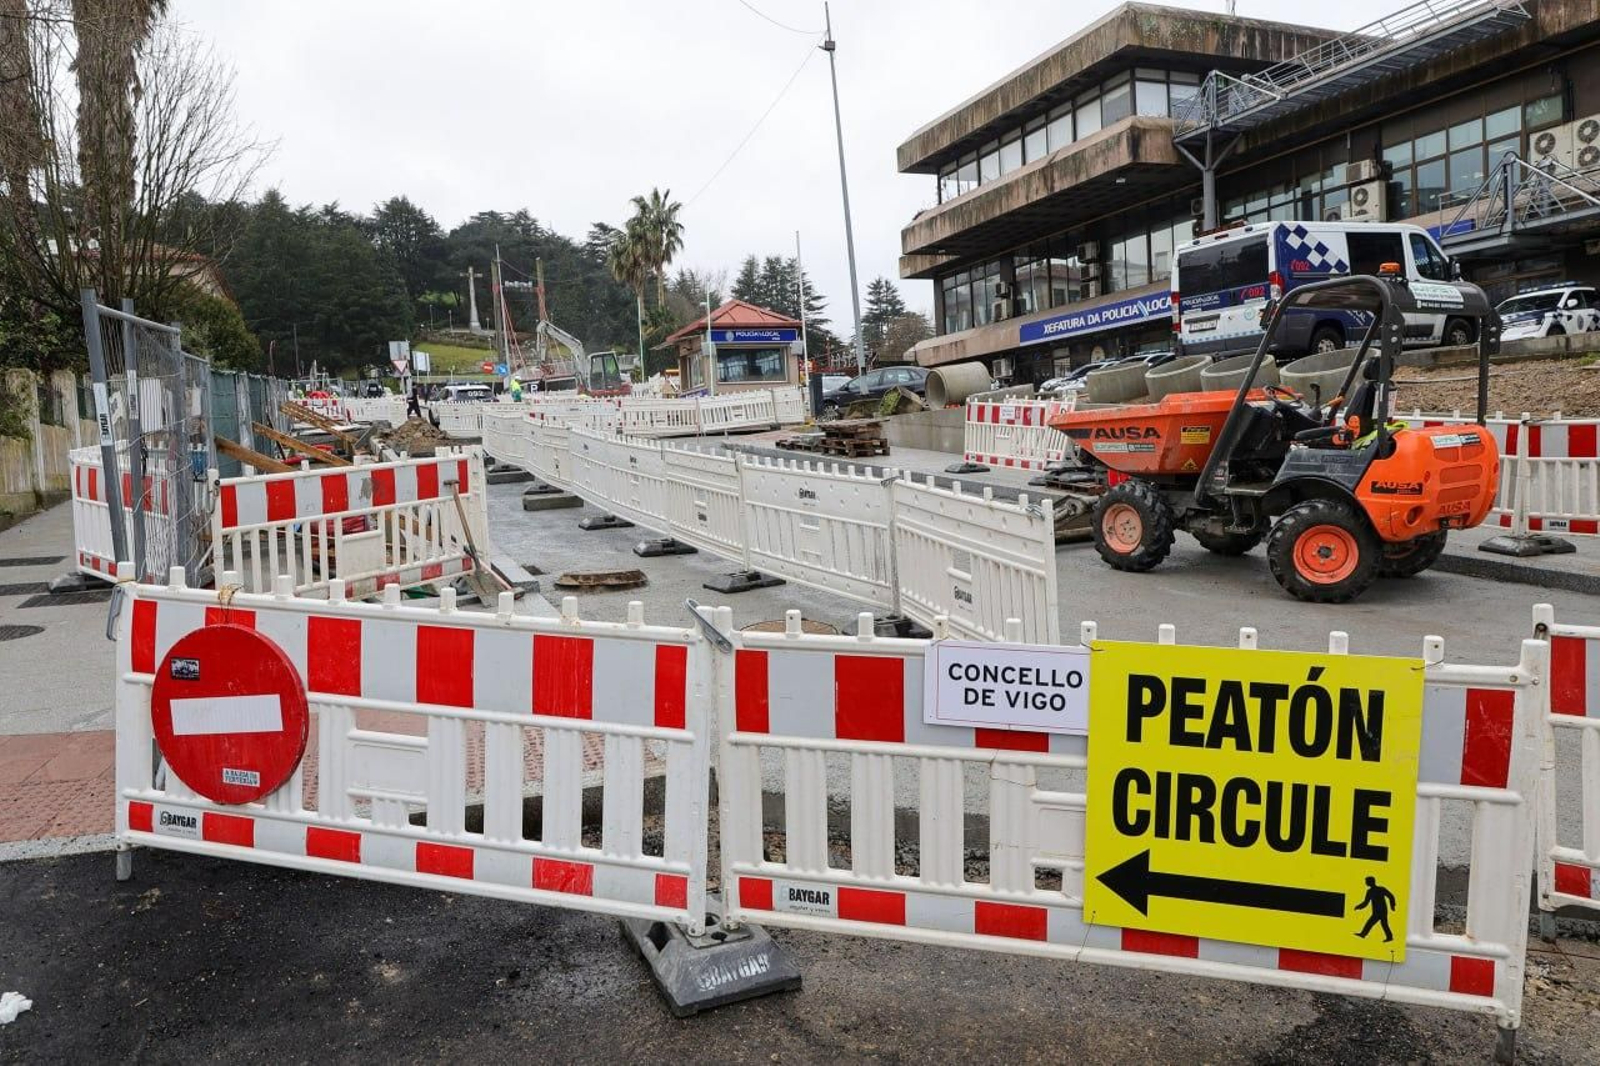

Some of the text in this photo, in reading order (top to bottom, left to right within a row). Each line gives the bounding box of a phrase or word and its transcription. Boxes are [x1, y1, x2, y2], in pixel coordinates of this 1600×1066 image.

[1248, 286, 1266, 298] 092
[1044, 316, 1085, 335] XEFATURA
[1087, 314, 1100, 324] DA
[1146, 297, 1172, 312] LOCA
[1095, 426, 1161, 440] AUSA
[1374, 481, 1420, 490] AUSA
[948, 662, 1083, 689] CONCELLO
[964, 687, 1066, 711] DE VIGO
[1126, 666, 1385, 762] PEATÓN
[167, 813, 197, 829] BAYGAR
[1112, 767, 1392, 862] CIRCULE
[788, 887, 830, 905] BAYGAR
